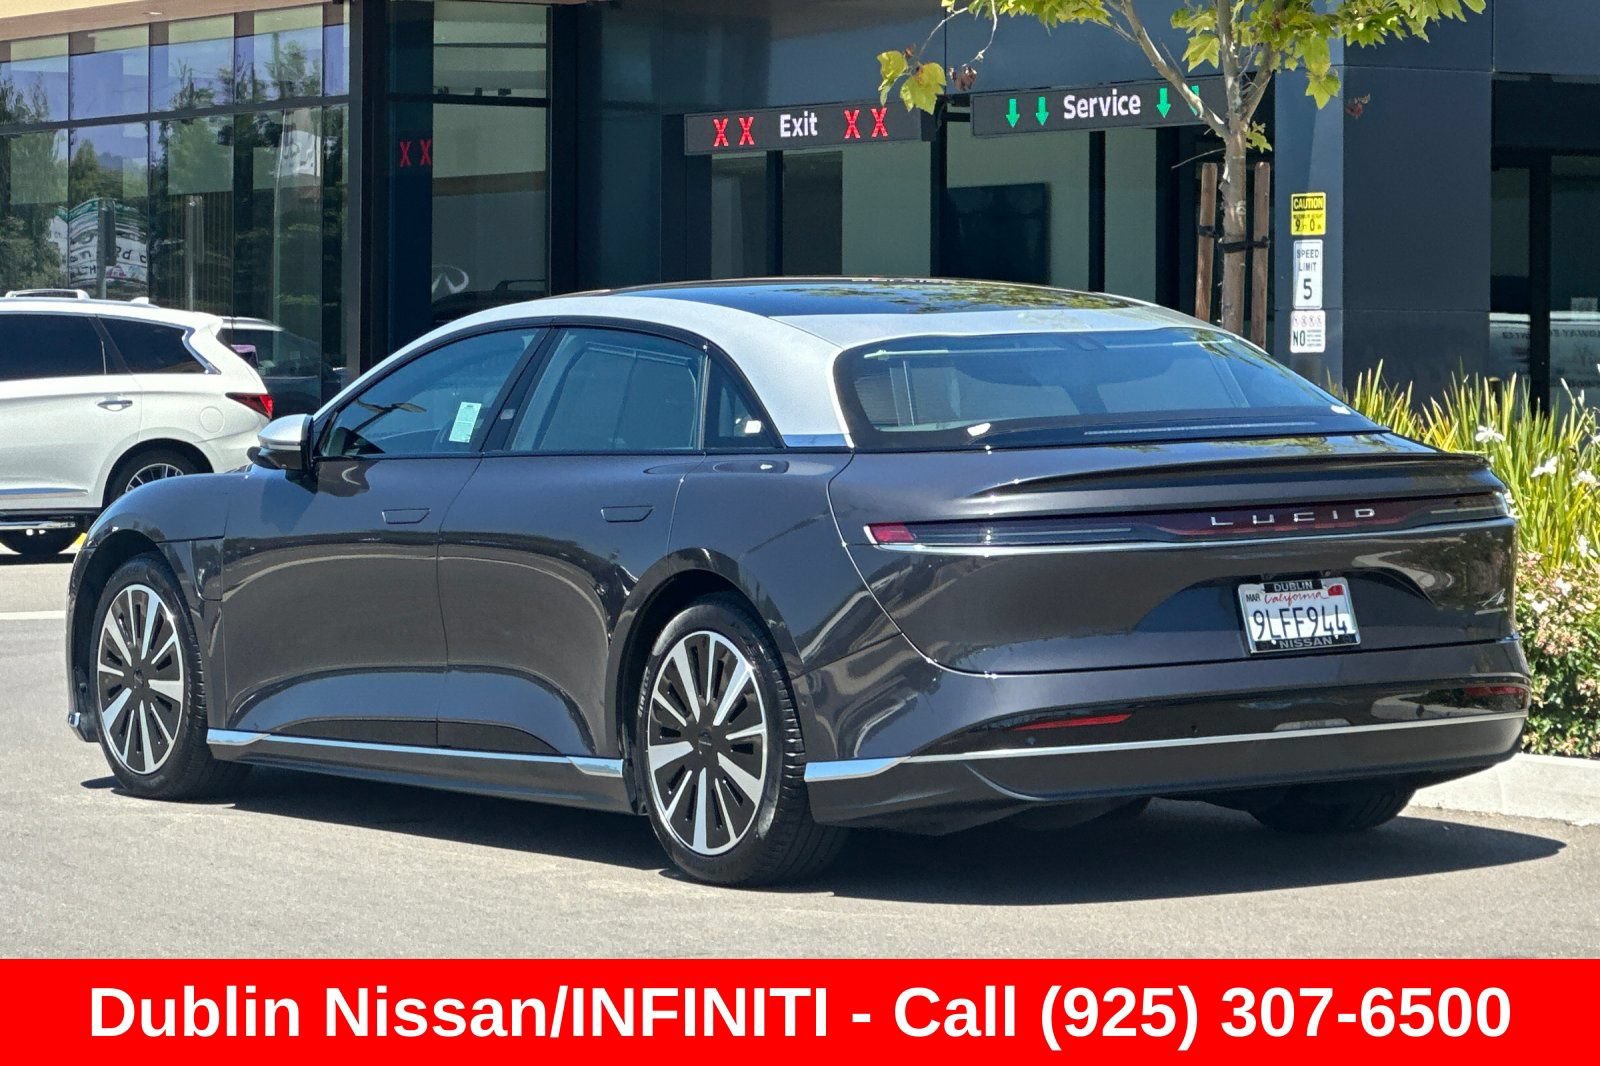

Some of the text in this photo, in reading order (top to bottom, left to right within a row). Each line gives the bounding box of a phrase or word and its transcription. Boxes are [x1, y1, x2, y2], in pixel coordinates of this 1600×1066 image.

[1063, 88, 1142, 120] Service
[779, 110, 818, 138] Exit
[1293, 197, 1323, 210] CAUTION
[1297, 248, 1320, 259] SPEED
[1298, 261, 1317, 272] LIMIT
[1303, 278, 1313, 300] 5
[1293, 329, 1306, 347] NO
[1211, 508, 1376, 526] LUCID
[1274, 580, 1313, 592] DUBLIN
[1245, 591, 1329, 606] MAR California
[1253, 604, 1348, 640] 9LFF944
[1280, 636, 1334, 649] NISSAN
